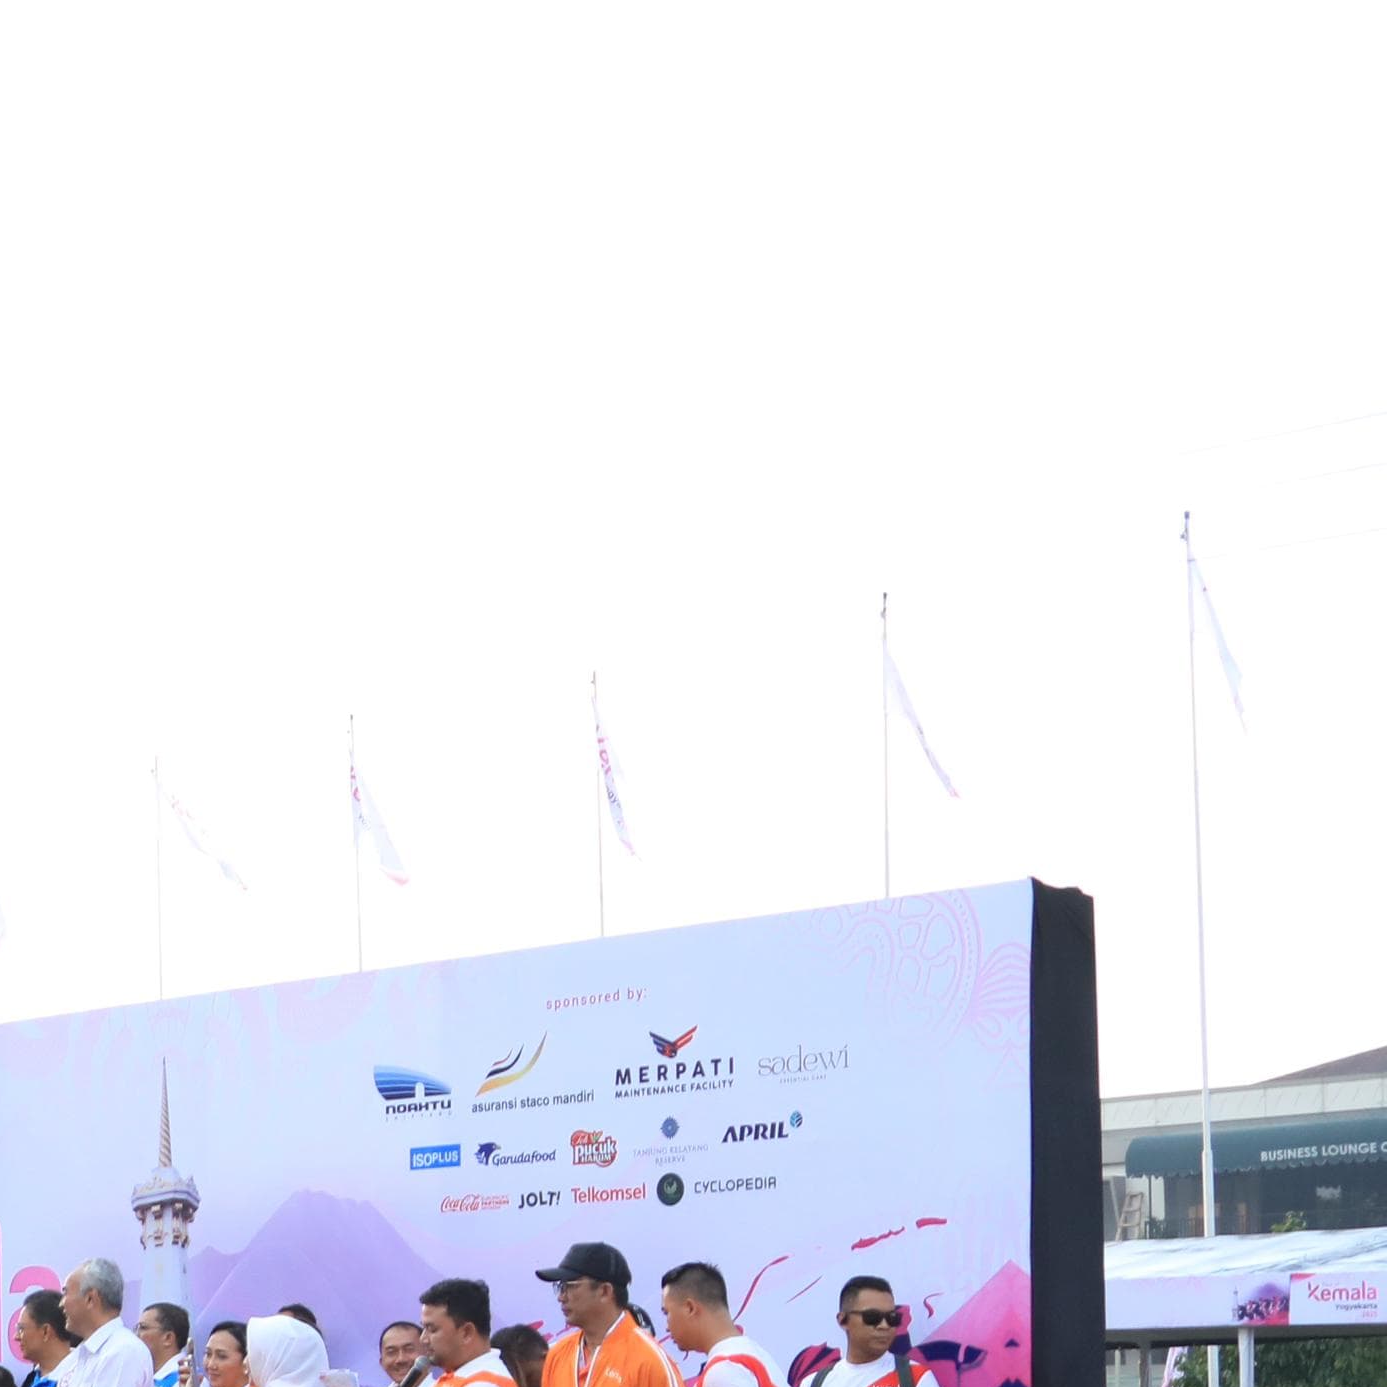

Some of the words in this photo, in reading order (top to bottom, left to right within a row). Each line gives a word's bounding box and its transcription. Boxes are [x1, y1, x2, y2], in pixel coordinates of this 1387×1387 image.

[546, 988, 621, 1011] sponsored
[627, 987, 648, 1003] by:
[615, 1057, 735, 1086] MERPATI
[615, 1083, 687, 1098] MAINTENANCE
[690, 1079, 735, 1092] FACILITY
[472, 1097, 517, 1113] asuransi
[520, 1094, 550, 1108] staco
[552, 1089, 594, 1105] mandiri
[722, 1122, 789, 1143] APRIL
[412, 1150, 459, 1167] ISOPLUS
[492, 1149, 556, 1166] Garudafood
[1261, 1146, 1318, 1162] BUSINESS
[1322, 1142, 1377, 1157] LOUNGE
[571, 1183, 646, 1204] Telkomsel
[694, 1177, 777, 1194] CYCLOPEDIA
[518, 1191, 561, 1209] JOLT!
[1307, 1280, 1377, 1302] Kemala
